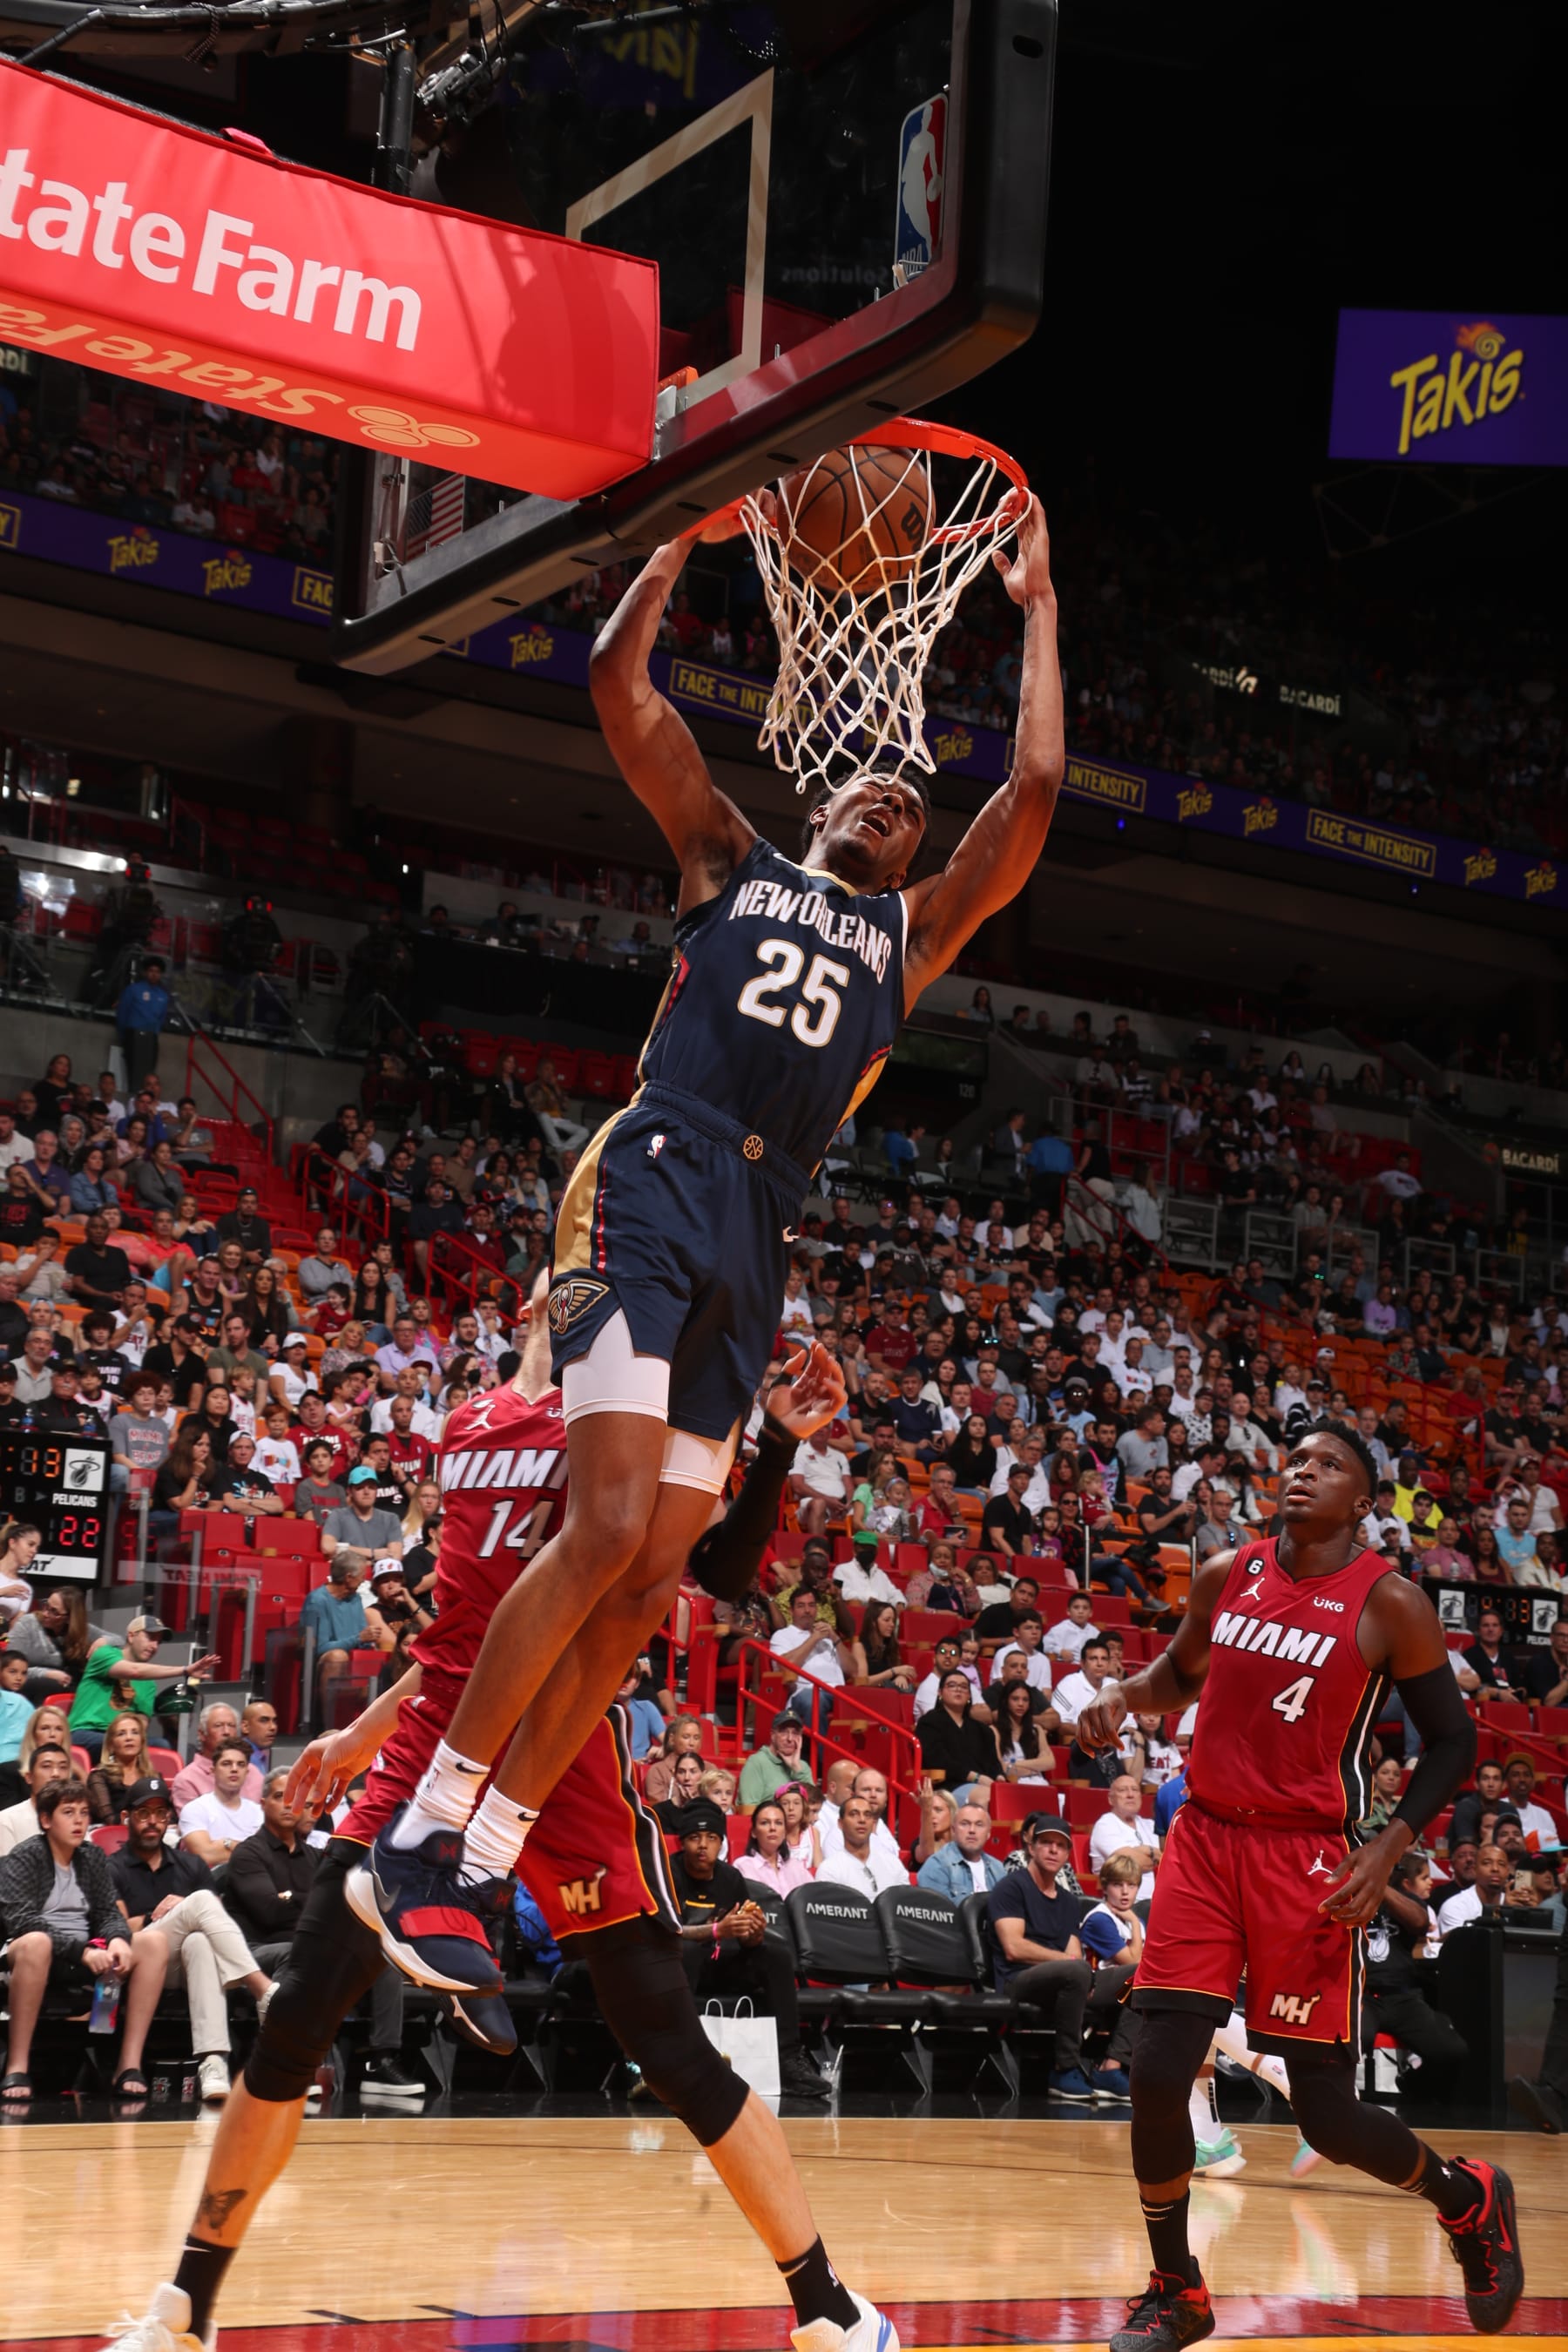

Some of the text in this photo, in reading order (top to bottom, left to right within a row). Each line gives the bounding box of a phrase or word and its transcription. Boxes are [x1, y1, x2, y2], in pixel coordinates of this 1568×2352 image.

[0, 148, 186, 284] tate
[1390, 336, 1524, 456] Takis
[107, 532, 160, 573] Takis
[202, 556, 253, 597] Takis
[302, 577, 334, 607] FAC
[509, 631, 555, 669] Takis
[677, 666, 718, 701] FACE
[718, 684, 739, 704] THE
[933, 730, 974, 767] Takis
[1066, 761, 1141, 804] INTENSITY
[1176, 786, 1213, 822] Takis
[1242, 801, 1279, 837] Takis
[1313, 816, 1345, 844] FACE
[1363, 831, 1430, 870] INTENSITY
[1463, 851, 1497, 887] Takis
[1524, 865, 1558, 899] Takis
[727, 879, 893, 985] NEW ORLEANS
[737, 938, 850, 1048] 25
[441, 1449, 569, 1493] MIAMI
[52, 1492, 98, 1508] PELICANS
[58, 1515, 100, 1548] 22
[476, 1499, 556, 1559] 14
[1248, 1559, 1263, 1575] 6
[1313, 1596, 1345, 1612] UKG
[1211, 1611, 1338, 1668] MIAMI
[1271, 1674, 1316, 1724] 4
[806, 1902, 868, 1921] AMERANT
[896, 1903, 955, 1924] AMERANT
